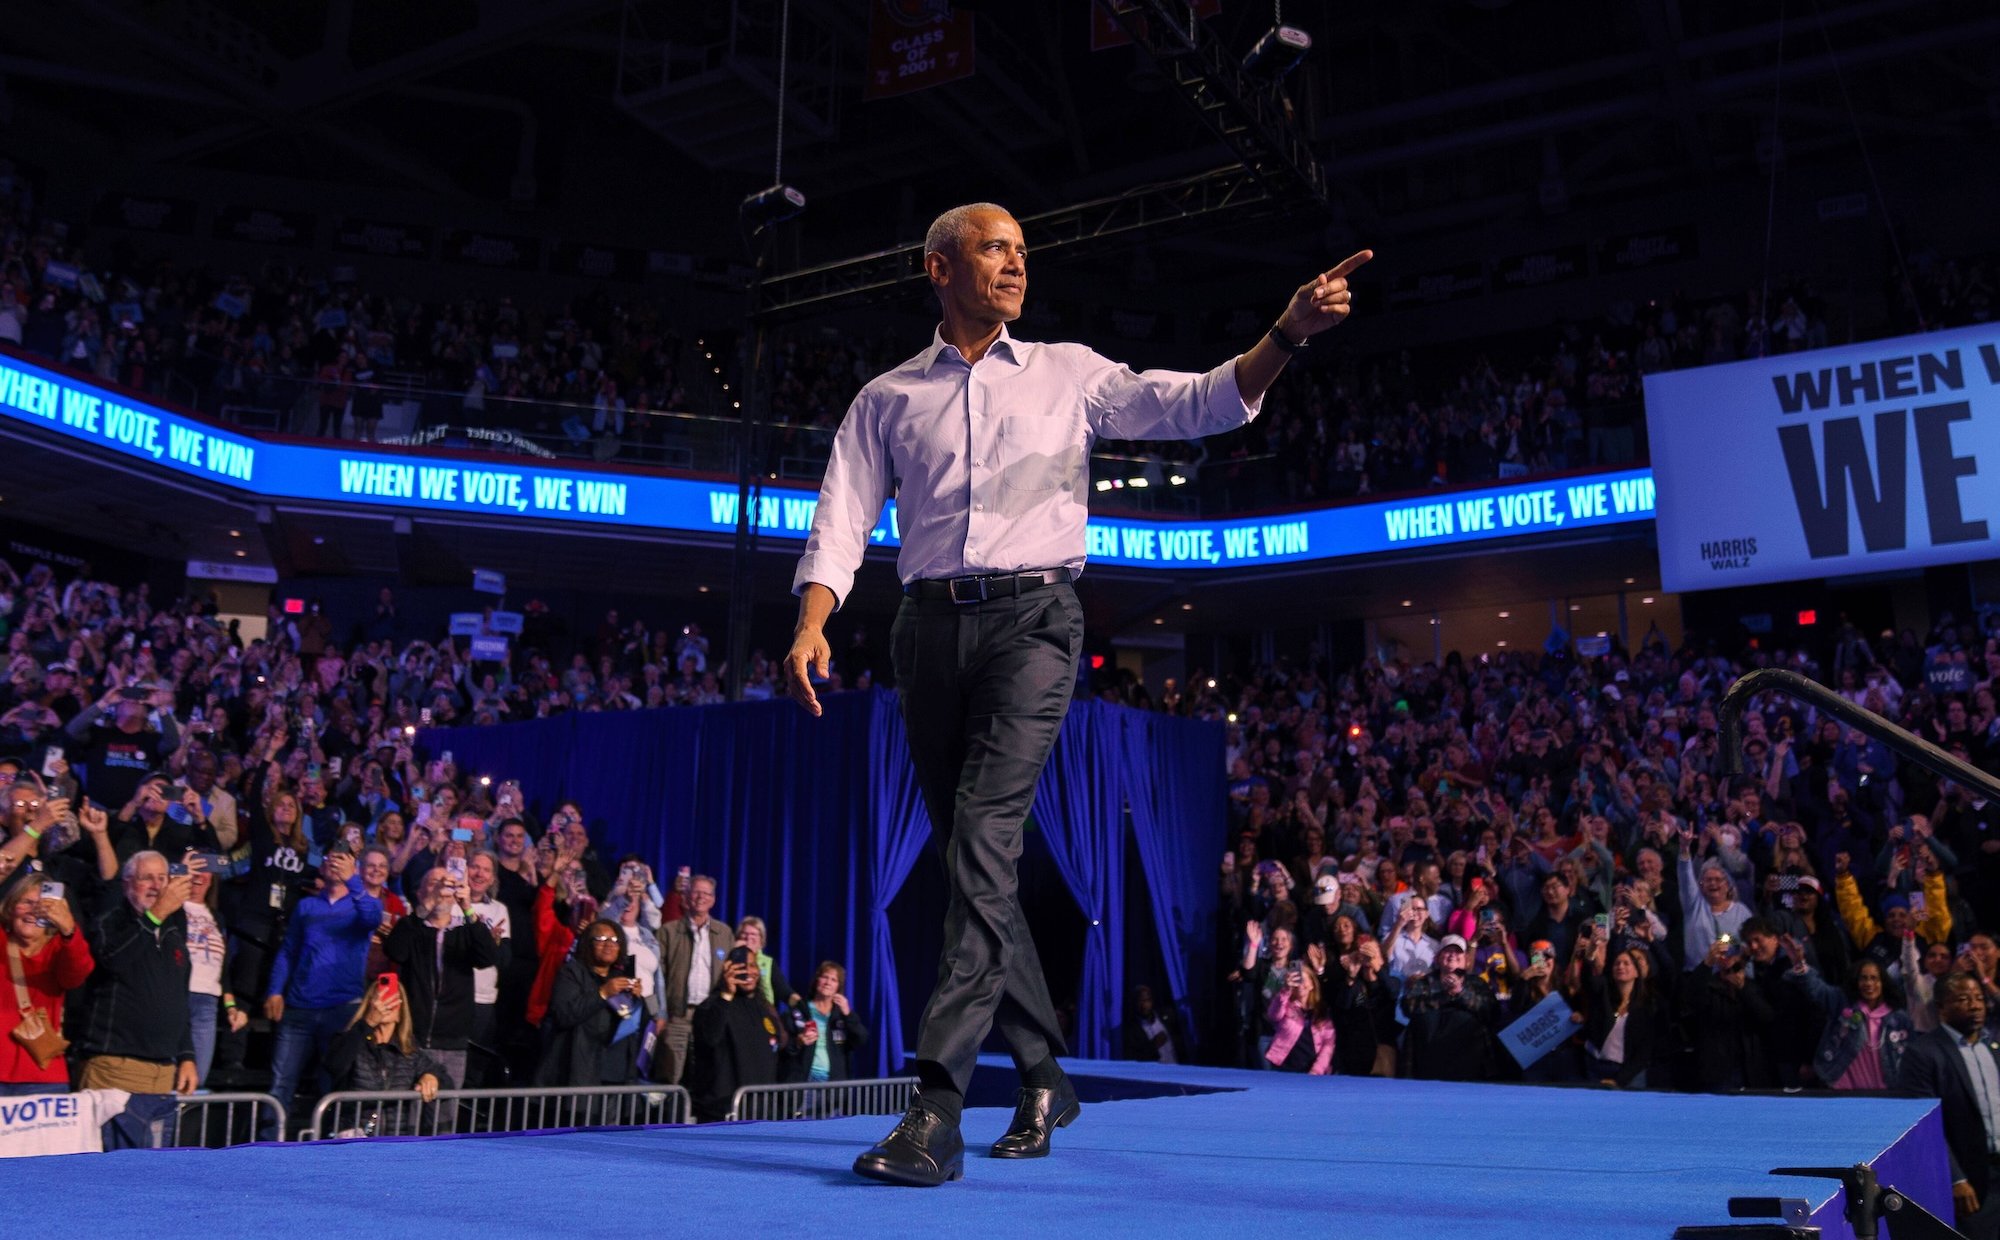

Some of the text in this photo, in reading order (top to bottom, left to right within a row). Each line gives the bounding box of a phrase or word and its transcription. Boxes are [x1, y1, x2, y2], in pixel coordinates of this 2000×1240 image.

[890, 29, 945, 53] CLASS
[907, 46, 929, 62] OF
[898, 57, 936, 78] 2001
[1772, 350, 1965, 414] WHEN
[62, 386, 102, 434] WE
[104, 400, 164, 459] VOTE,
[169, 423, 205, 467] WE
[207, 435, 254, 481] WIN
[340, 459, 627, 516] WHEN WE VOTE, WE WIN
[1777, 400, 1990, 560] WE
[1384, 502, 1454, 541] WHEN
[1456, 497, 1495, 532] WE
[1498, 489, 1565, 527] VOTE,
[1567, 483, 1608, 519] WE
[1121, 527, 1156, 560] WE
[1158, 529, 1221, 564] VOTE,
[1223, 526, 1260, 559] WE
[1262, 521, 1309, 556] WIN
[1700, 537, 1757, 561] HARRIS
[1711, 556, 1750, 570] WALZ
[1929, 668, 1965, 683] vote
[1517, 1009, 1560, 1046] HARRIS
[1531, 1026, 1561, 1048] WALZ
[2, 1097, 79, 1125] VOTE!
